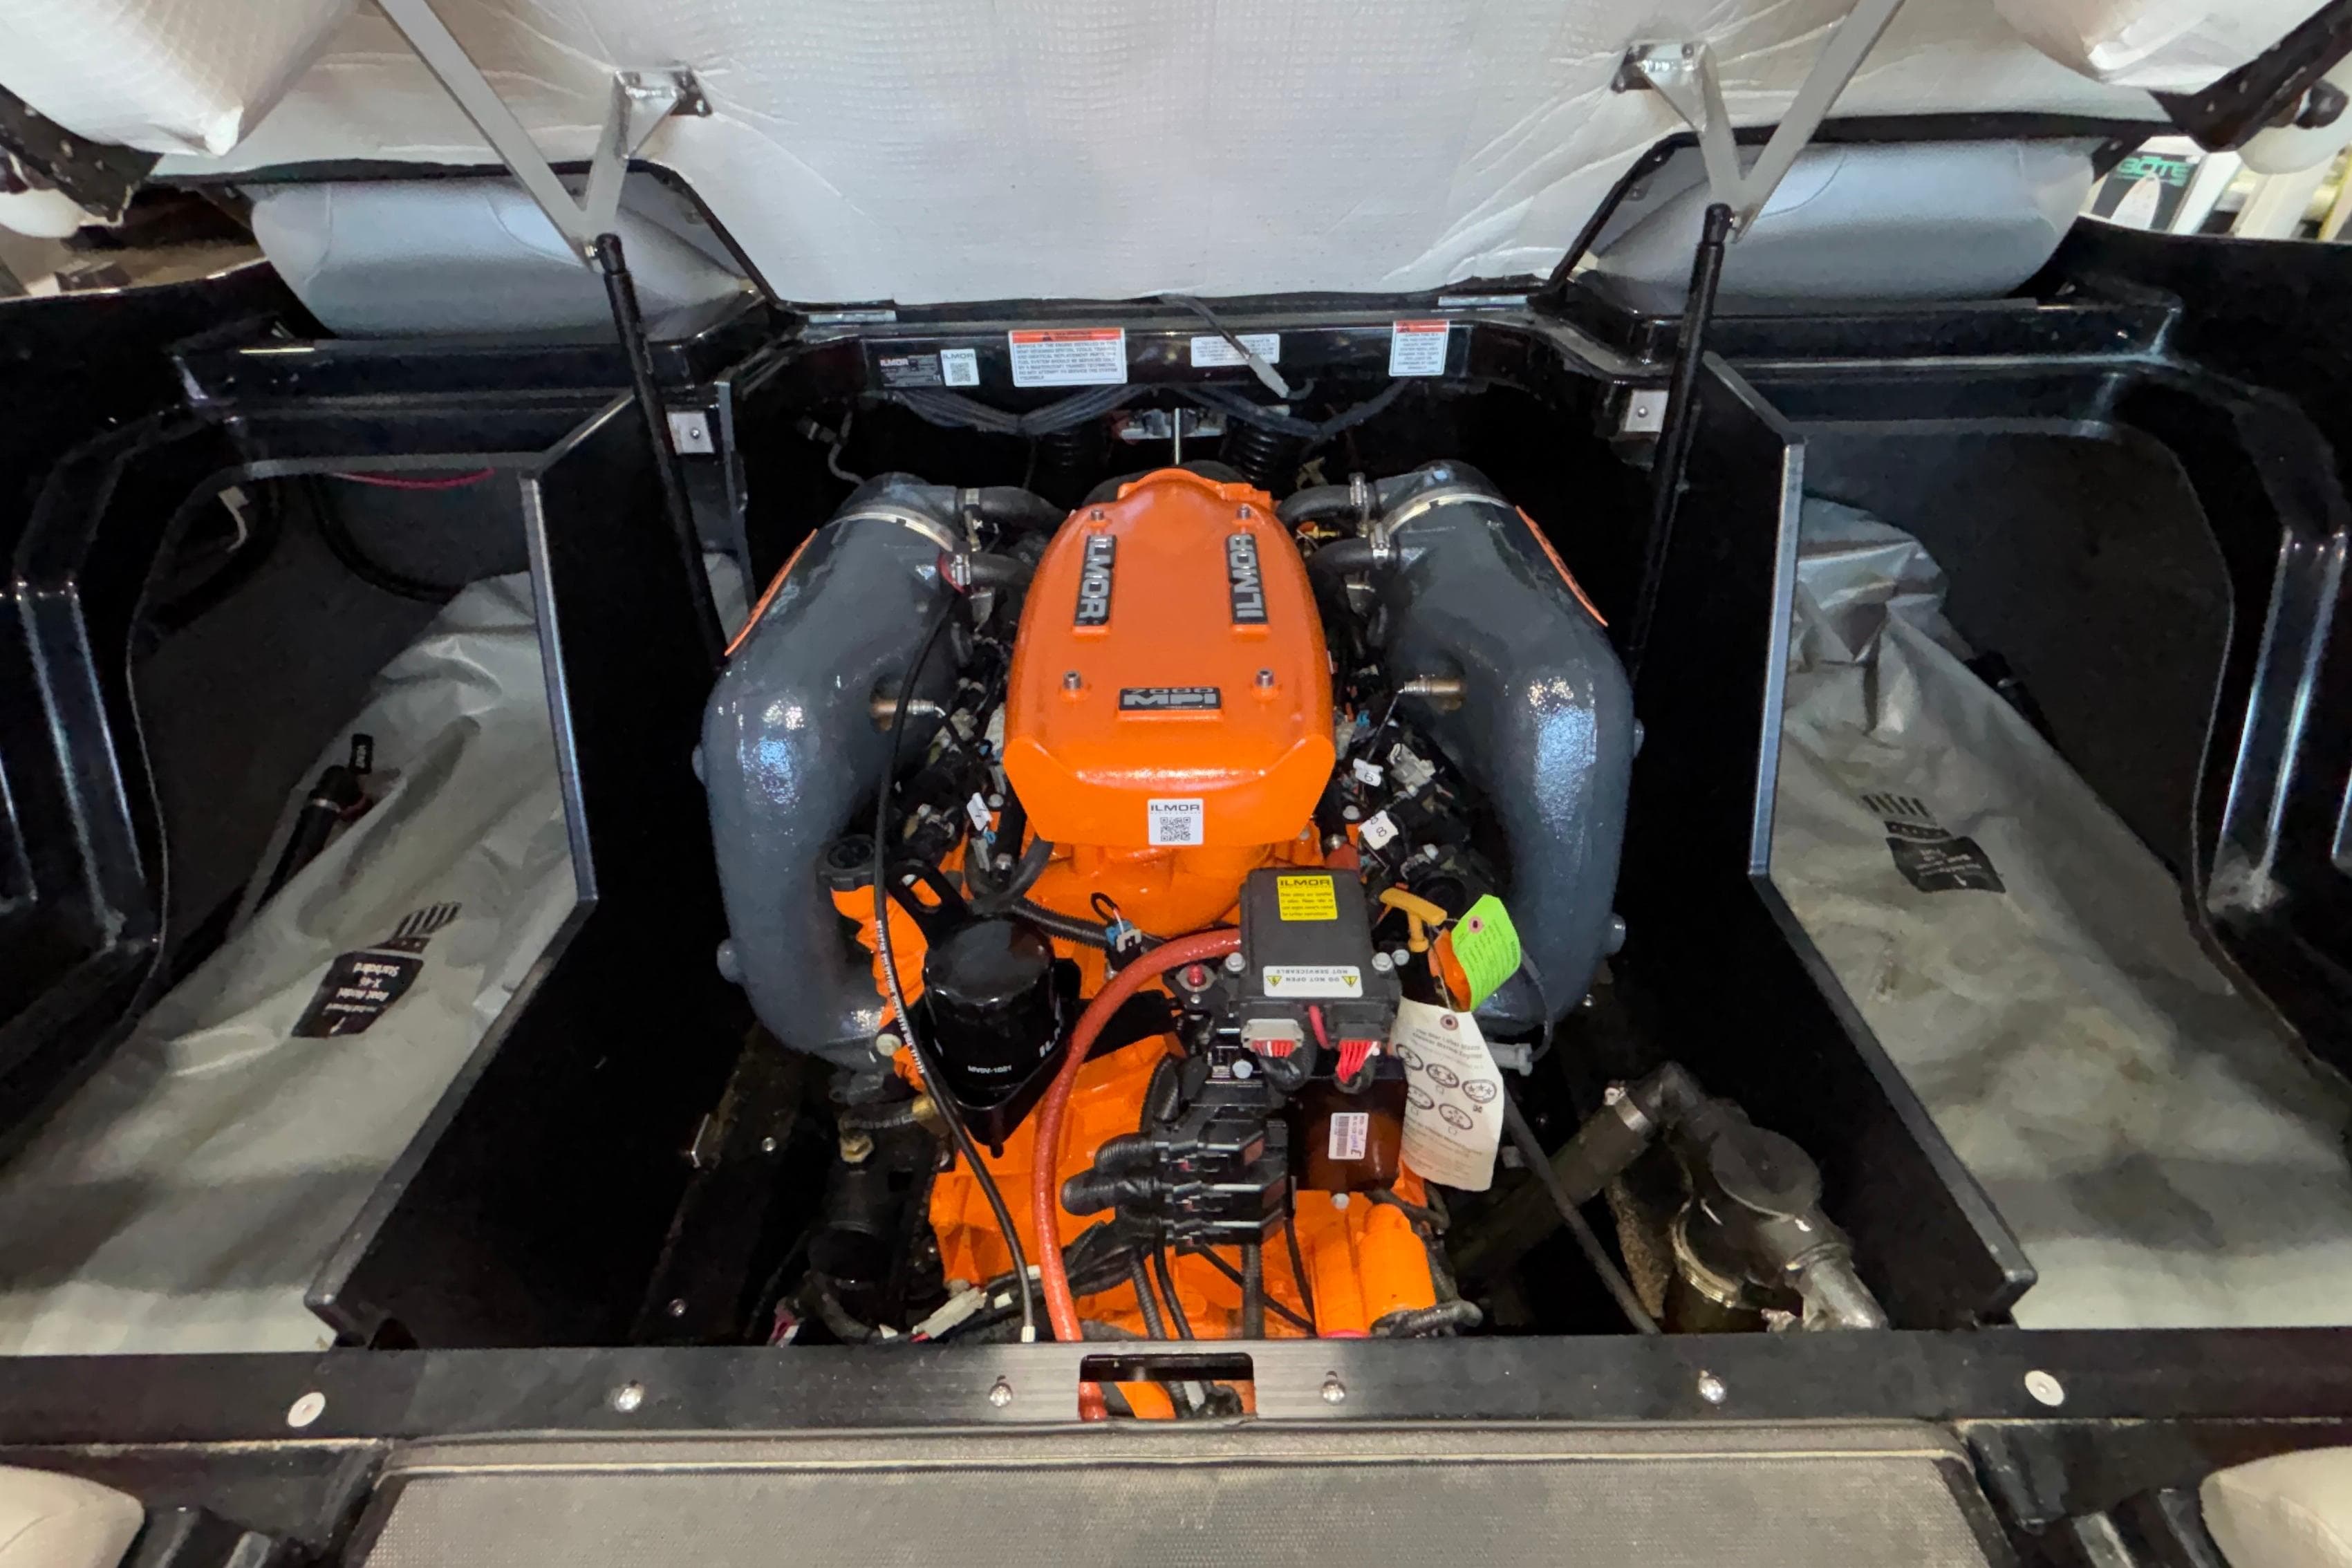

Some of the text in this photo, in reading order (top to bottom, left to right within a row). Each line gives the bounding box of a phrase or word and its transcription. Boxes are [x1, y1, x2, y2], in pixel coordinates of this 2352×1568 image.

[1078, 534, 1112, 619] ILMOR
[1229, 534, 1264, 618] ILMOR
[1123, 693, 1217, 706] MPI
